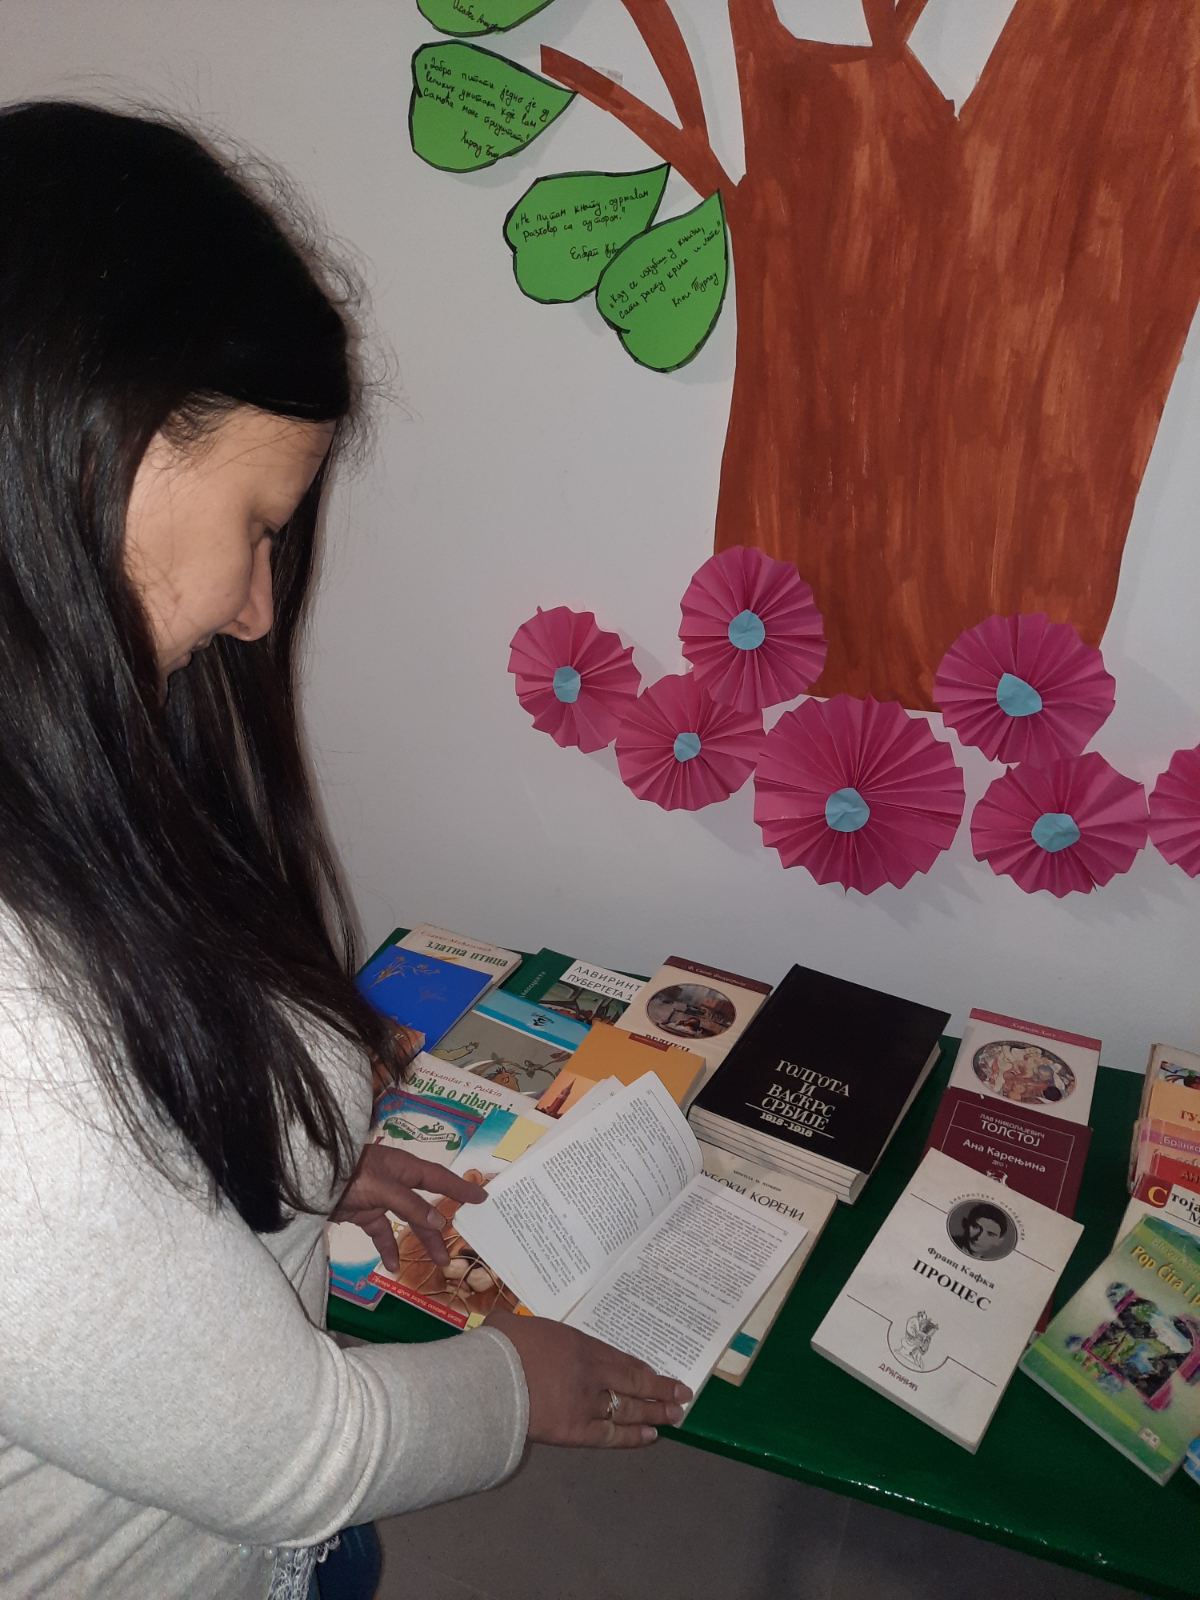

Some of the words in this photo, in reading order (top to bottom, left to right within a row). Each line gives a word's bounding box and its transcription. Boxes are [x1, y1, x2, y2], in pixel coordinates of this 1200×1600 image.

[525, 98, 536, 113] је
[667, 247, 677, 259] у
[566, 974, 624, 998] ПУБЕРТЕТА
[574, 966, 642, 992] ЛАВИРИНТ
[775, 1059, 850, 1097] ГОЛГОТА
[799, 1082, 817, 1097] И
[447, 1089, 457, 1100] o
[766, 1083, 836, 1118] ВАСКРС
[761, 1096, 829, 1131] СРБИЈЕ
[981, 1119, 1041, 1147] ТОЛСТОЈ
[962, 1139, 985, 1153] Ана
[987, 1146, 1046, 1173] Карењина
[750, 1191, 805, 1222] КОРЕНИ
[927, 1247, 959, 1269] Франц
[960, 1264, 995, 1289] Кафка
[1156, 1262, 1184, 1292] Ćira
[912, 1259, 992, 1311] ПРОЦЕС
